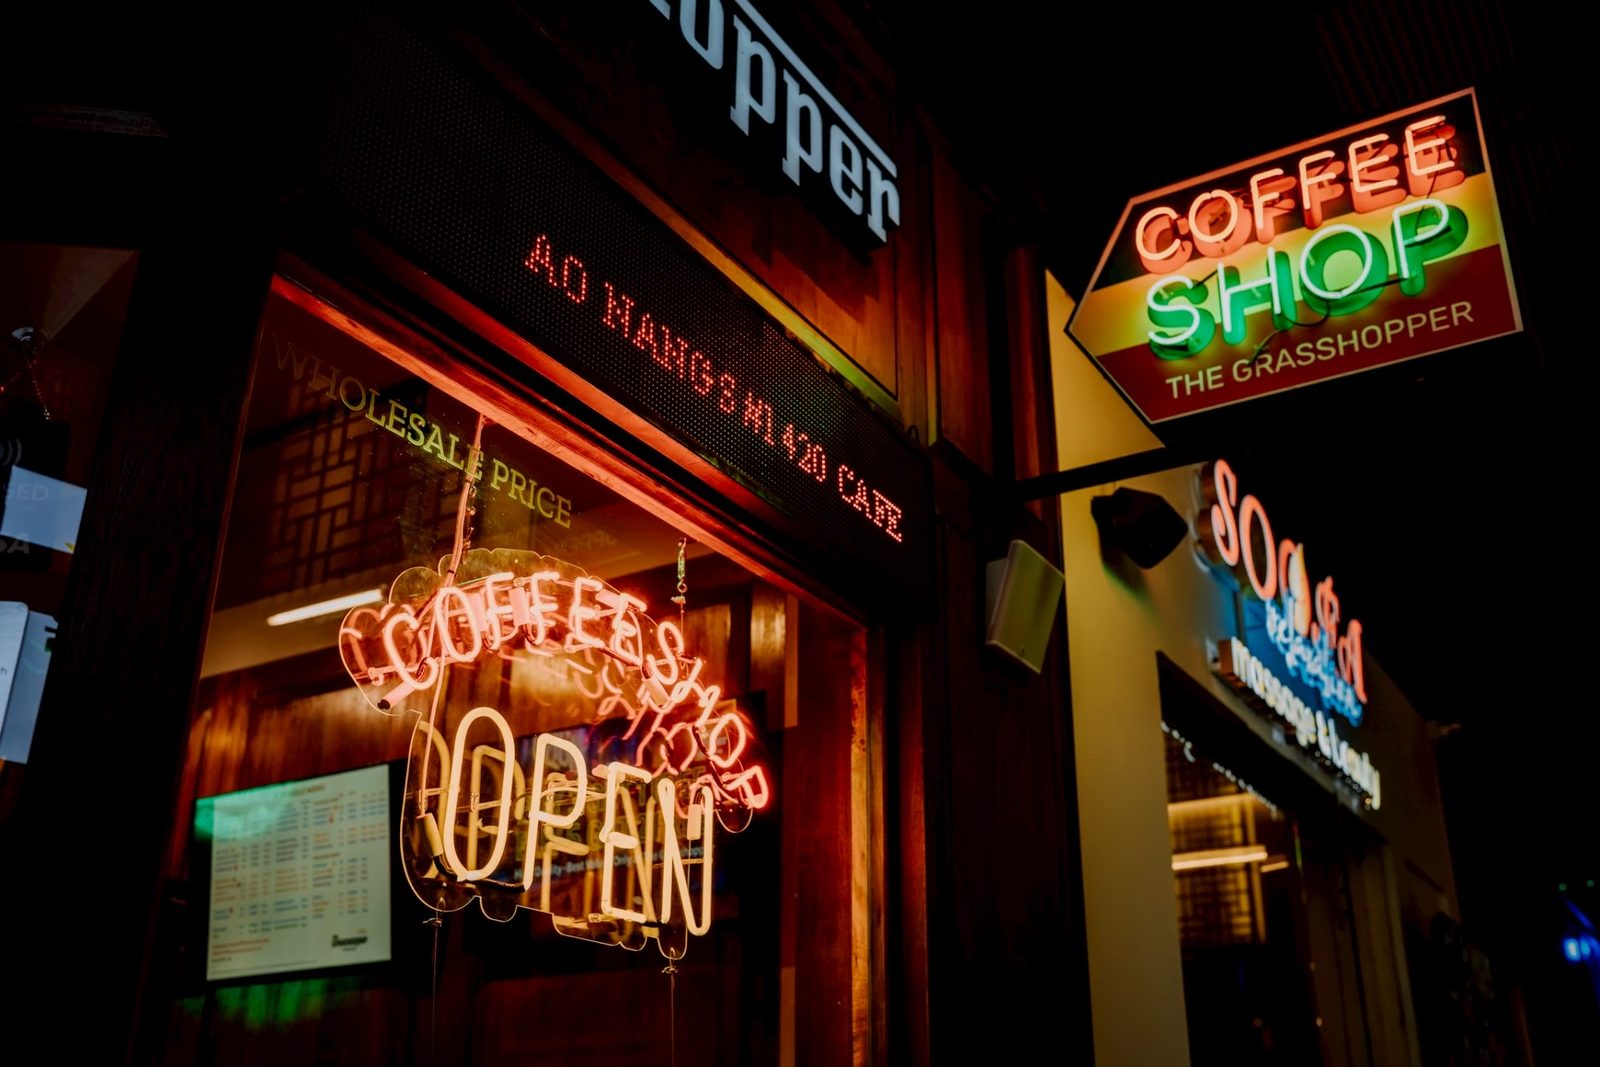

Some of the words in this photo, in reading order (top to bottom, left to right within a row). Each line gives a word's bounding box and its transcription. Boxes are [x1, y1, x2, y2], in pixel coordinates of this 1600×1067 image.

[650, 0, 900, 243] opper
[1136, 116, 1463, 272] COFFEE
[1146, 198, 1468, 360] SHOP
[1166, 365, 1225, 399] THE
[1232, 301, 1475, 383] GRASSHOPPER
[274, 333, 484, 481] WHOLESALE
[490, 458, 573, 529] PRICE
[838, 464, 903, 543] CAFE
[383, 572, 648, 691] COFFEE
[646, 620, 769, 809] SHOP
[444, 707, 714, 937] OPEN
